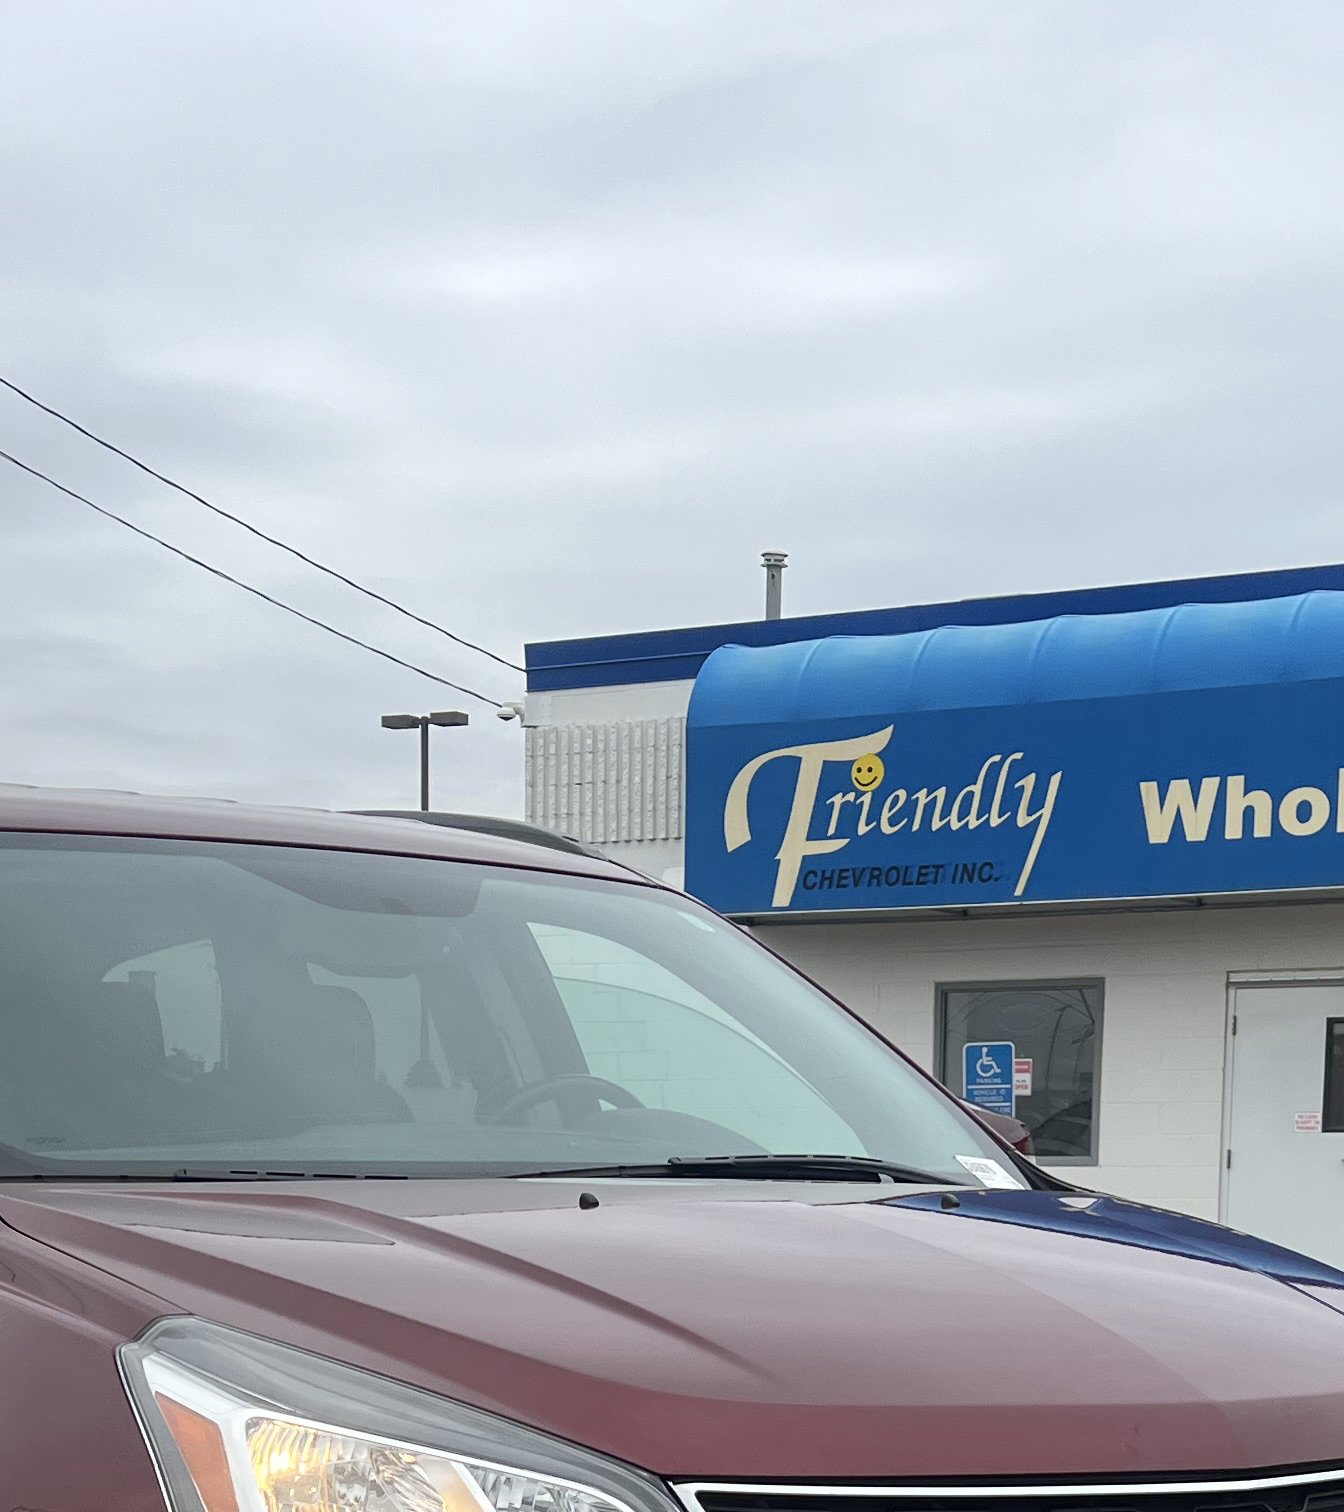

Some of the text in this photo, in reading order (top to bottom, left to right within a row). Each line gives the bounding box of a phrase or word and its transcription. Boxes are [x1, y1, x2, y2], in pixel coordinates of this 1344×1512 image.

[724, 725, 1062, 907] Friendly
[802, 861, 1002, 891] CHEVROLET INC.
